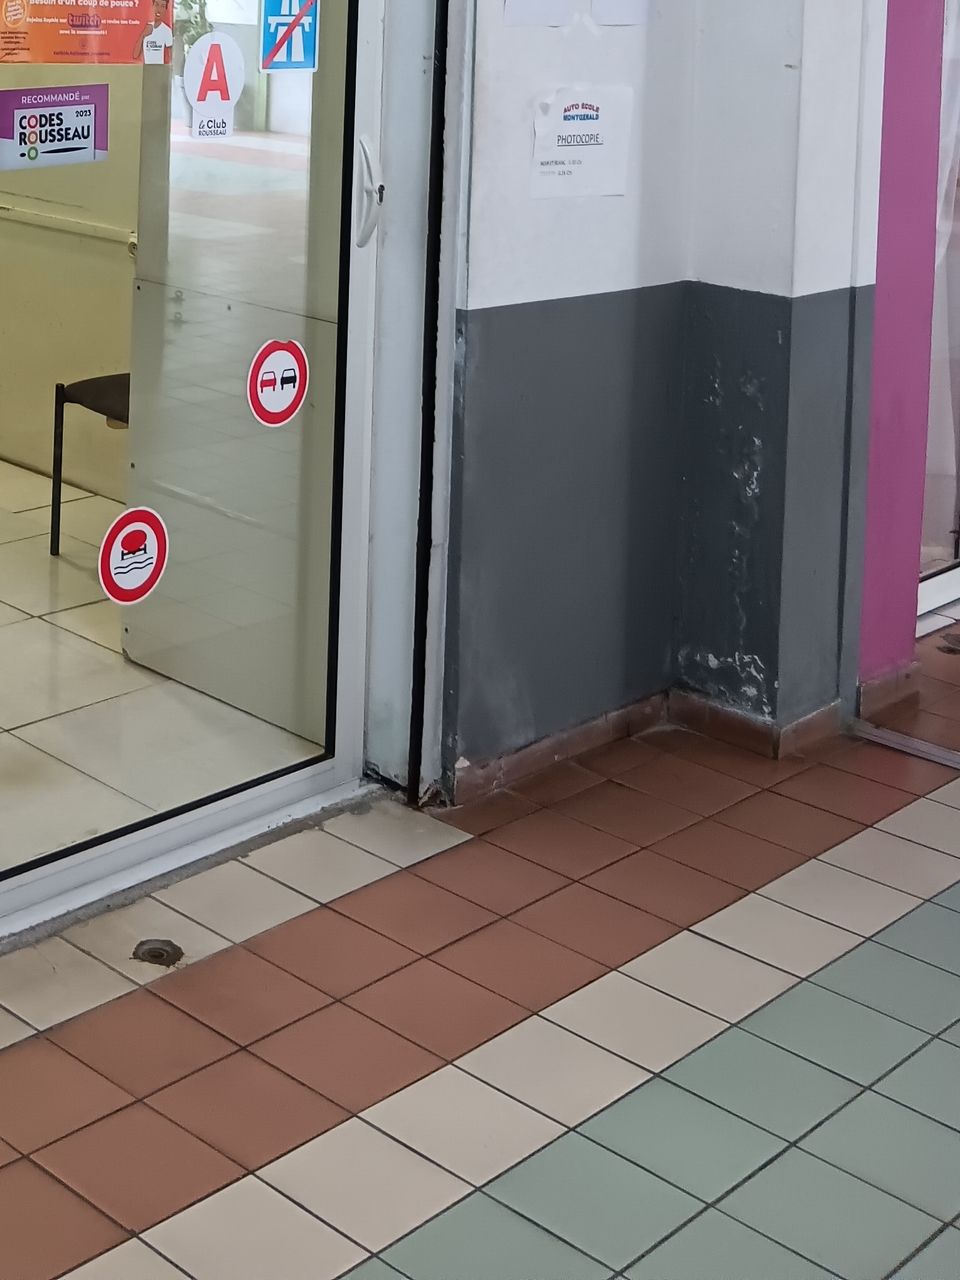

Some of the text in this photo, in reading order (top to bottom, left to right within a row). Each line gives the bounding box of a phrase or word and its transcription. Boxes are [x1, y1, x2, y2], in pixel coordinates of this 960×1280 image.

[110, 0, 134, 8] pouce
[68, 13, 101, 28] twitch
[197, 44, 230, 102] A
[21, 91, 80, 104] RECOMMANDÉ
[563, 103, 579, 113] AUTO
[19, 112, 64, 130] CODES
[206, 118, 227, 129] Club
[19, 125, 91, 146] ROUSSEAU
[557, 133, 600, 145] PHOTOCOPIE
